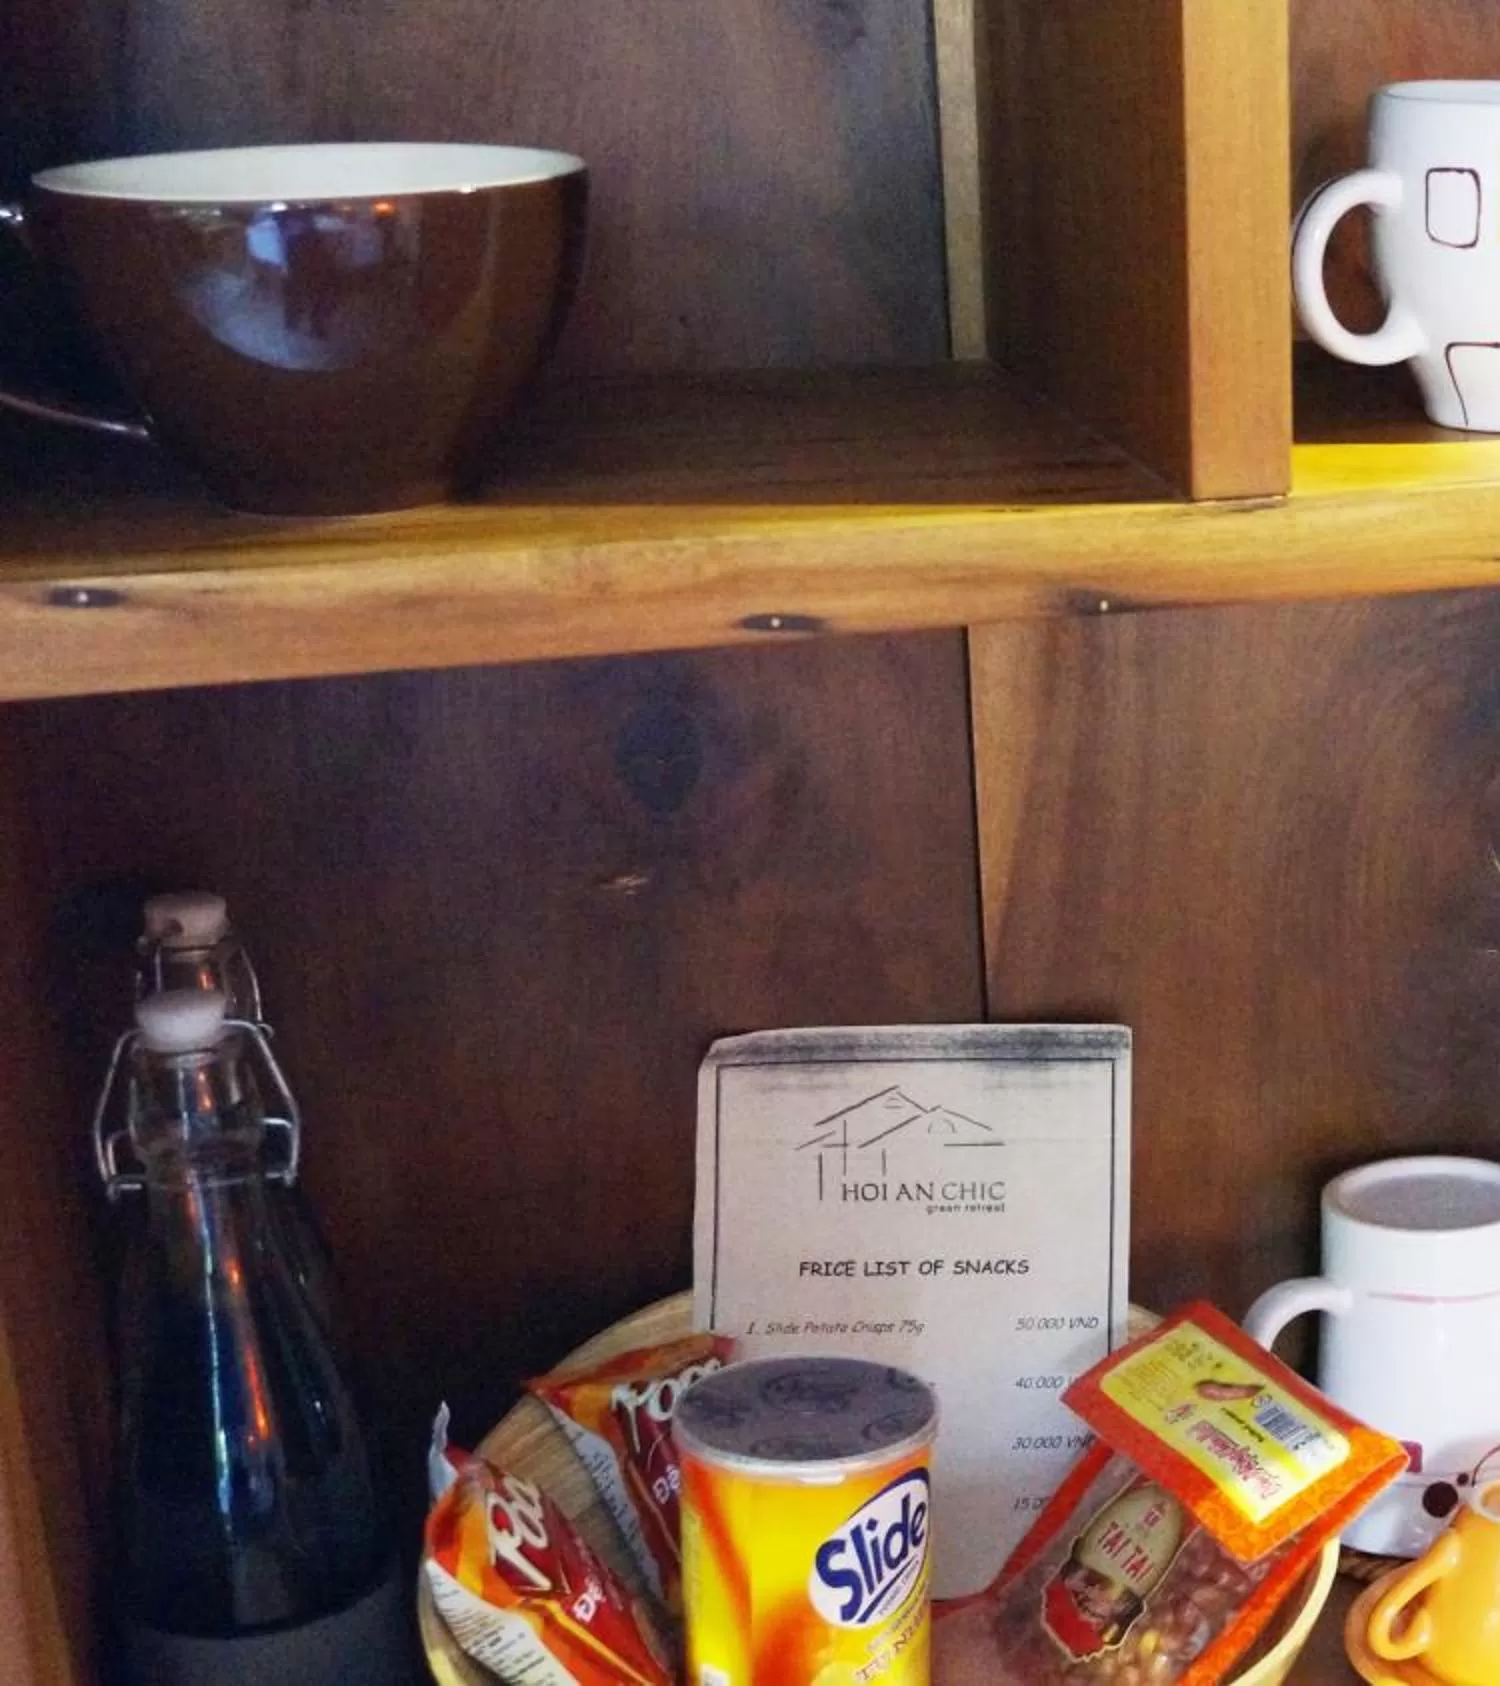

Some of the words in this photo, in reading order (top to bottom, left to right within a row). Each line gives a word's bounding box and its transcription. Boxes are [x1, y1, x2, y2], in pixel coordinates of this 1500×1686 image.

[842, 1183, 888, 1201] HOI
[895, 1183, 934, 1201] AN
[941, 1181, 1006, 1201] CHIC
[863, 1260, 911, 1276] LIST
[918, 1259, 944, 1276] OF
[952, 1258, 1030, 1276] SNACKS
[815, 1492, 926, 1623] Slide
